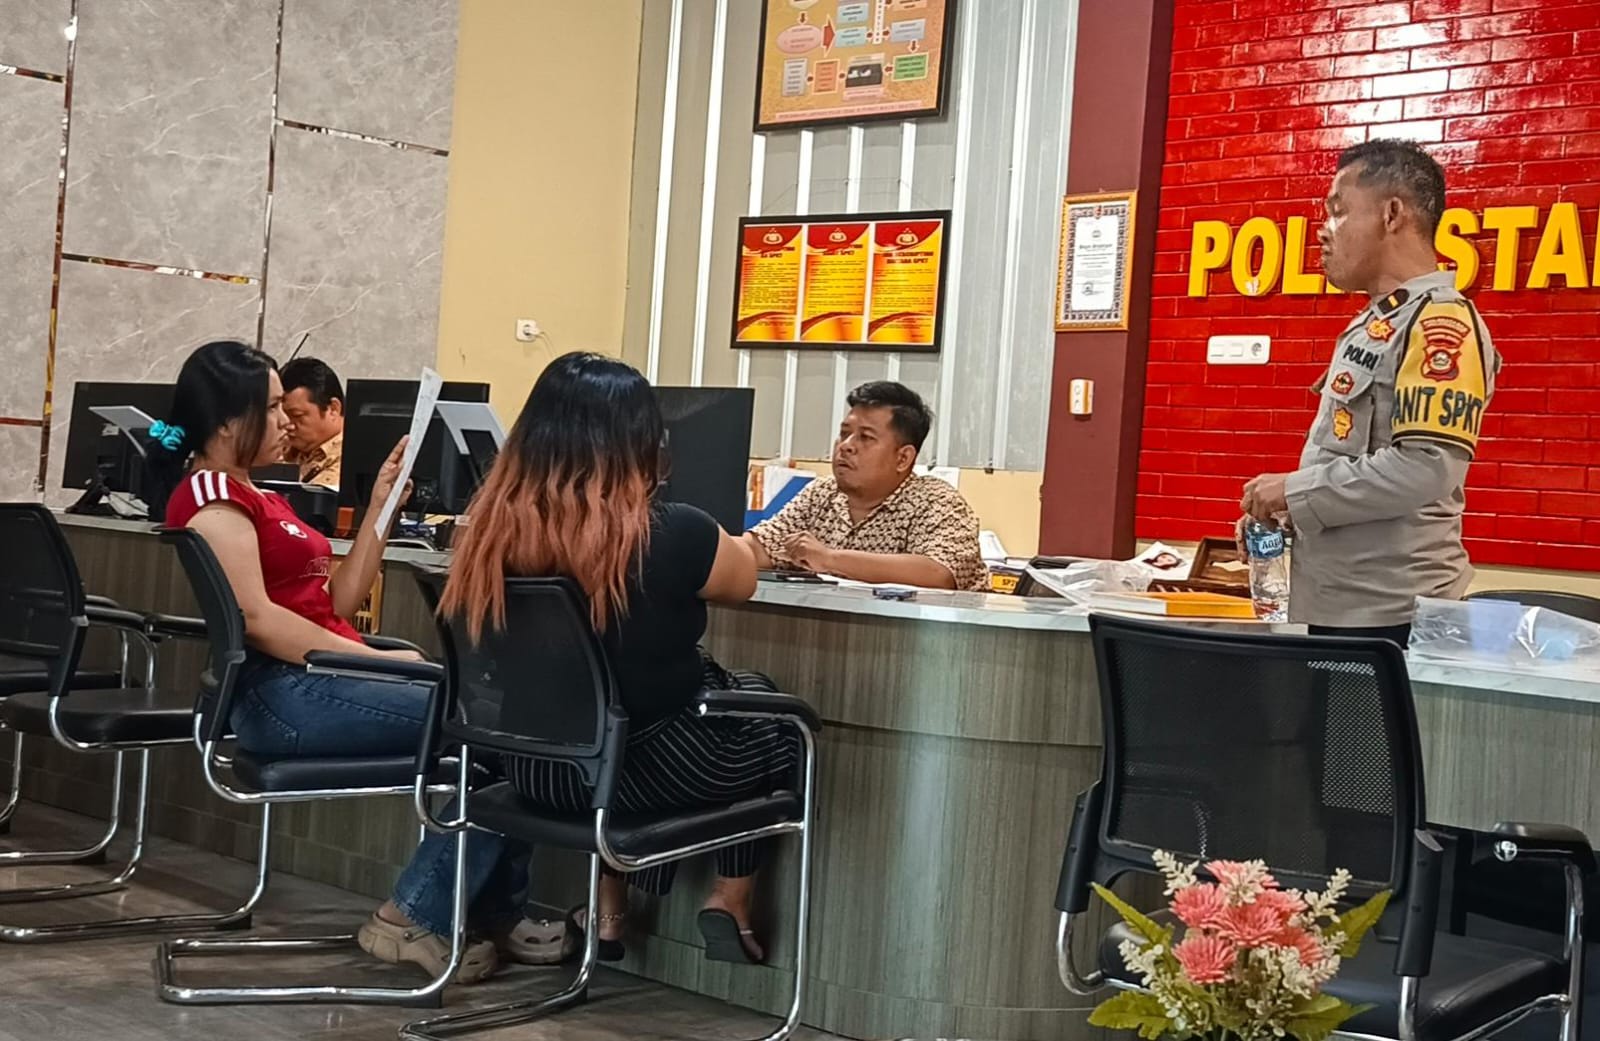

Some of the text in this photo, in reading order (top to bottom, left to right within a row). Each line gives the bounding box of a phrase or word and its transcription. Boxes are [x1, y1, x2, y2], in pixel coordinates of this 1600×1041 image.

[1187, 202, 1600, 297] POLSTA
[1343, 344, 1379, 371] POLRI
[1438, 388, 1483, 435] SPKT
